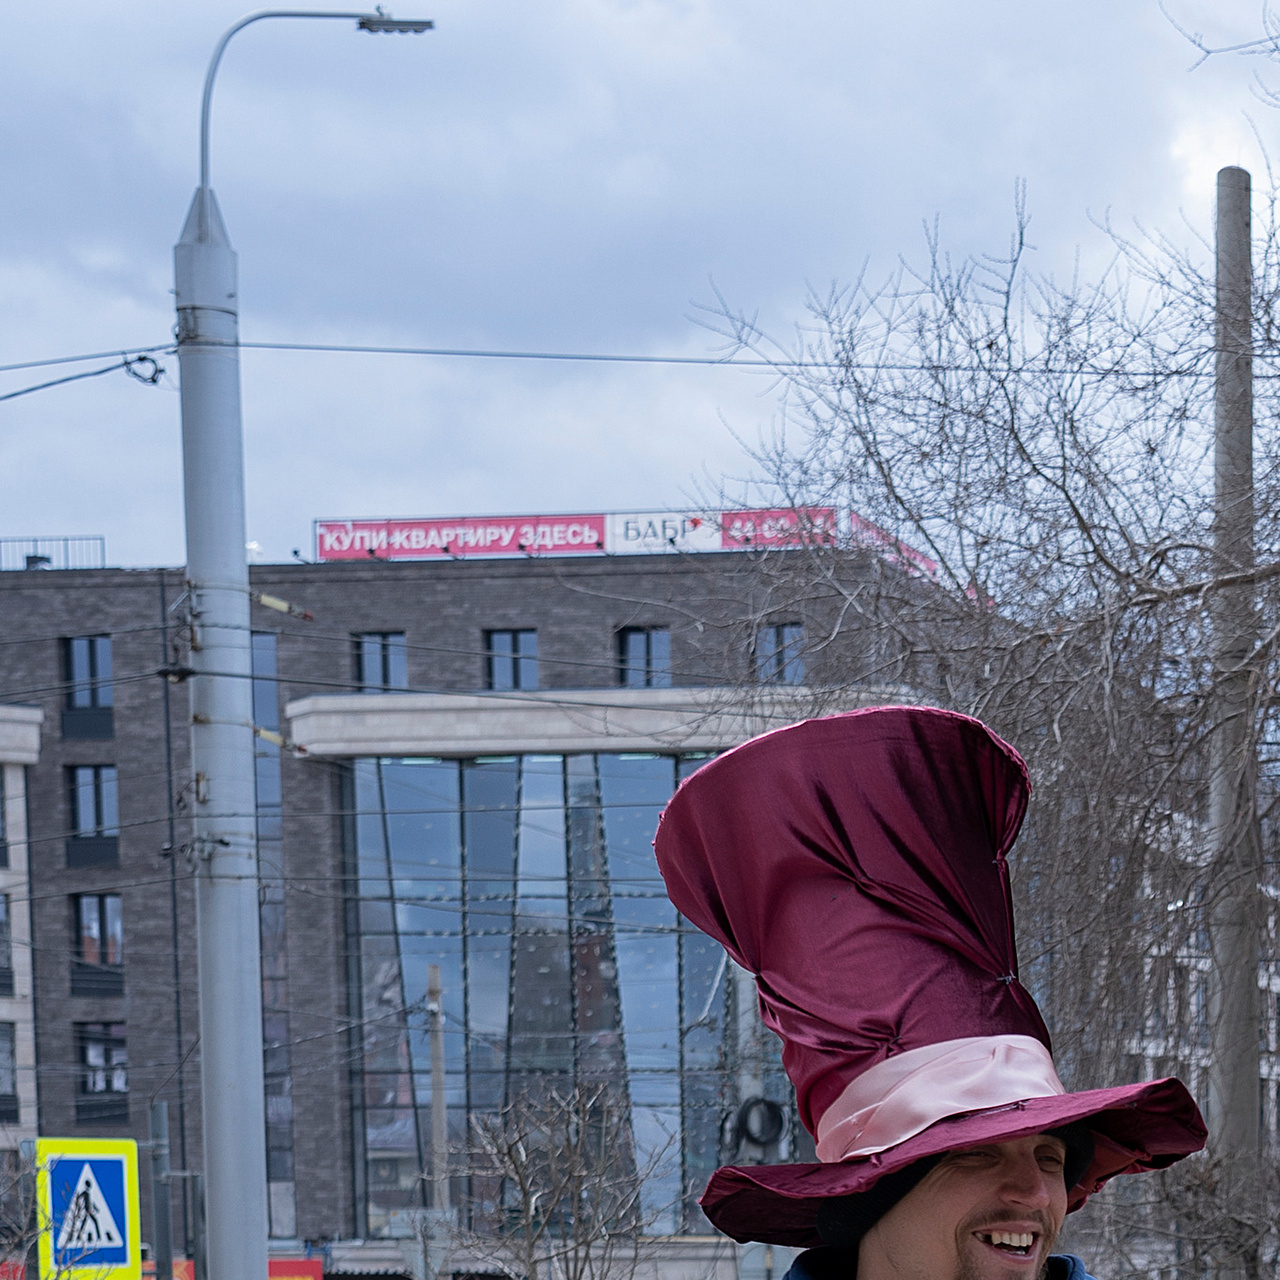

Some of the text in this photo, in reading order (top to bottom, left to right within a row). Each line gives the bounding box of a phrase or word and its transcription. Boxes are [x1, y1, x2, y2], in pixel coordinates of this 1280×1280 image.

[323, 523, 600, 551] КУПИ КВАРТИРУ ЗДЕСЬ
[623, 519, 697, 542] БАБР
